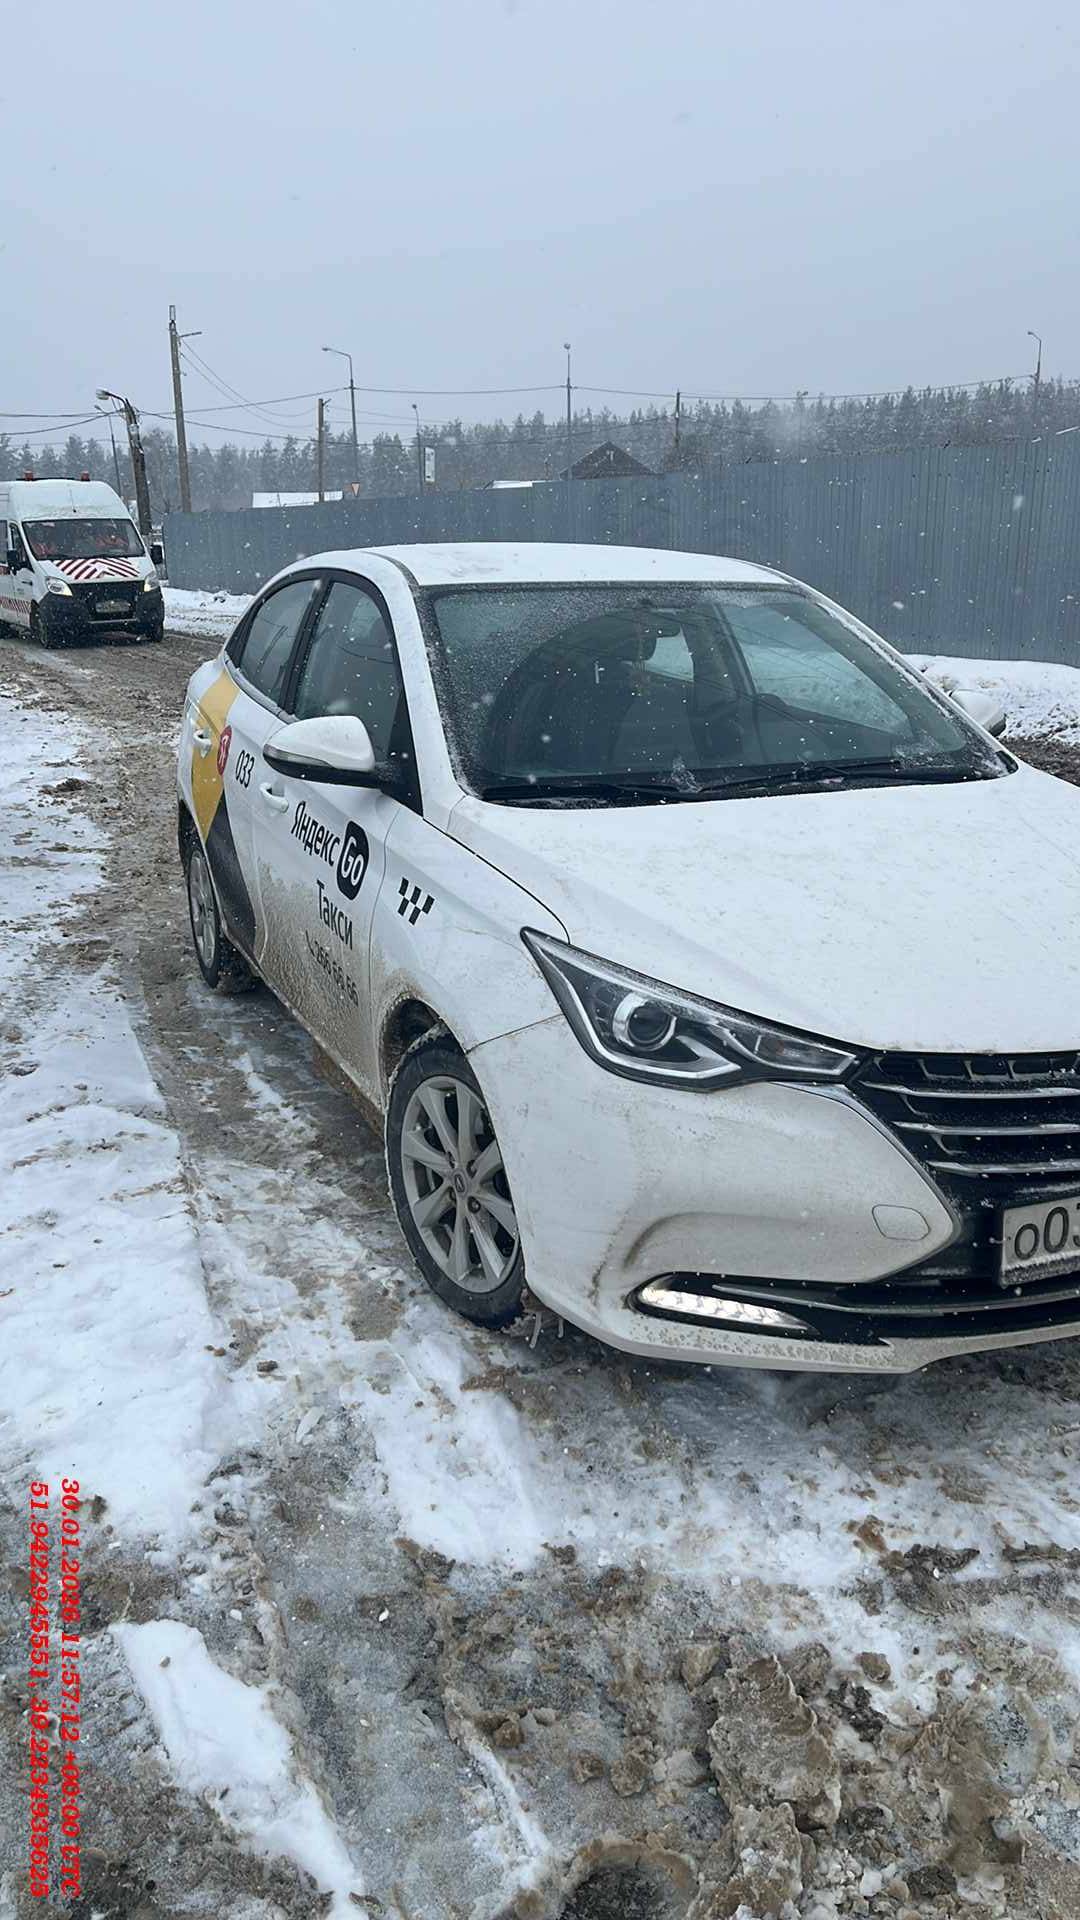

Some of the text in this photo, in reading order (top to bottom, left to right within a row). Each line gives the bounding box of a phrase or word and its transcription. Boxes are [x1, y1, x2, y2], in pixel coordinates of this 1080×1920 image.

[235, 749, 255, 788] 033
[291, 801, 366, 887] Яндекс Go
[316, 879, 353, 950] Такси
